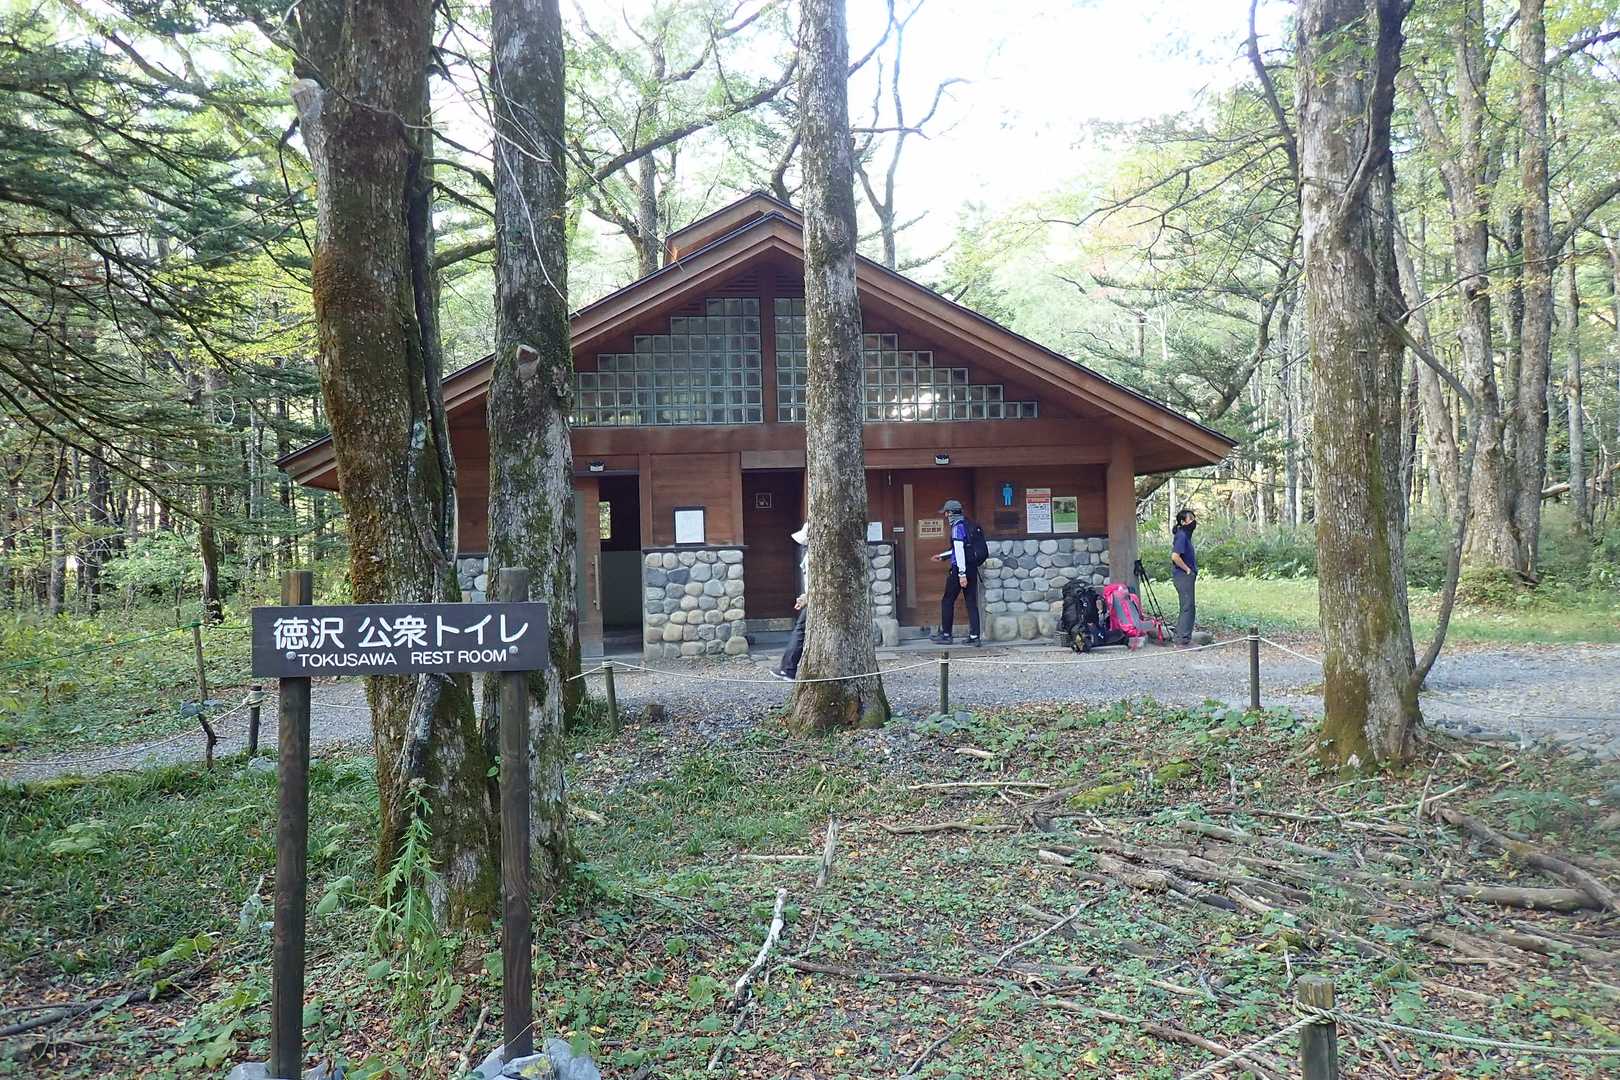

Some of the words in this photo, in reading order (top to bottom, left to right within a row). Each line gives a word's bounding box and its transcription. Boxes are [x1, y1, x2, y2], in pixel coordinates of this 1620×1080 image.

[273, 616, 344, 650] 徳沢
[358, 614, 529, 648] 公衆トイレ
[298, 652, 397, 667] TOKUSAWA
[411, 651, 454, 665] REST
[458, 649, 507, 663] ROOM
